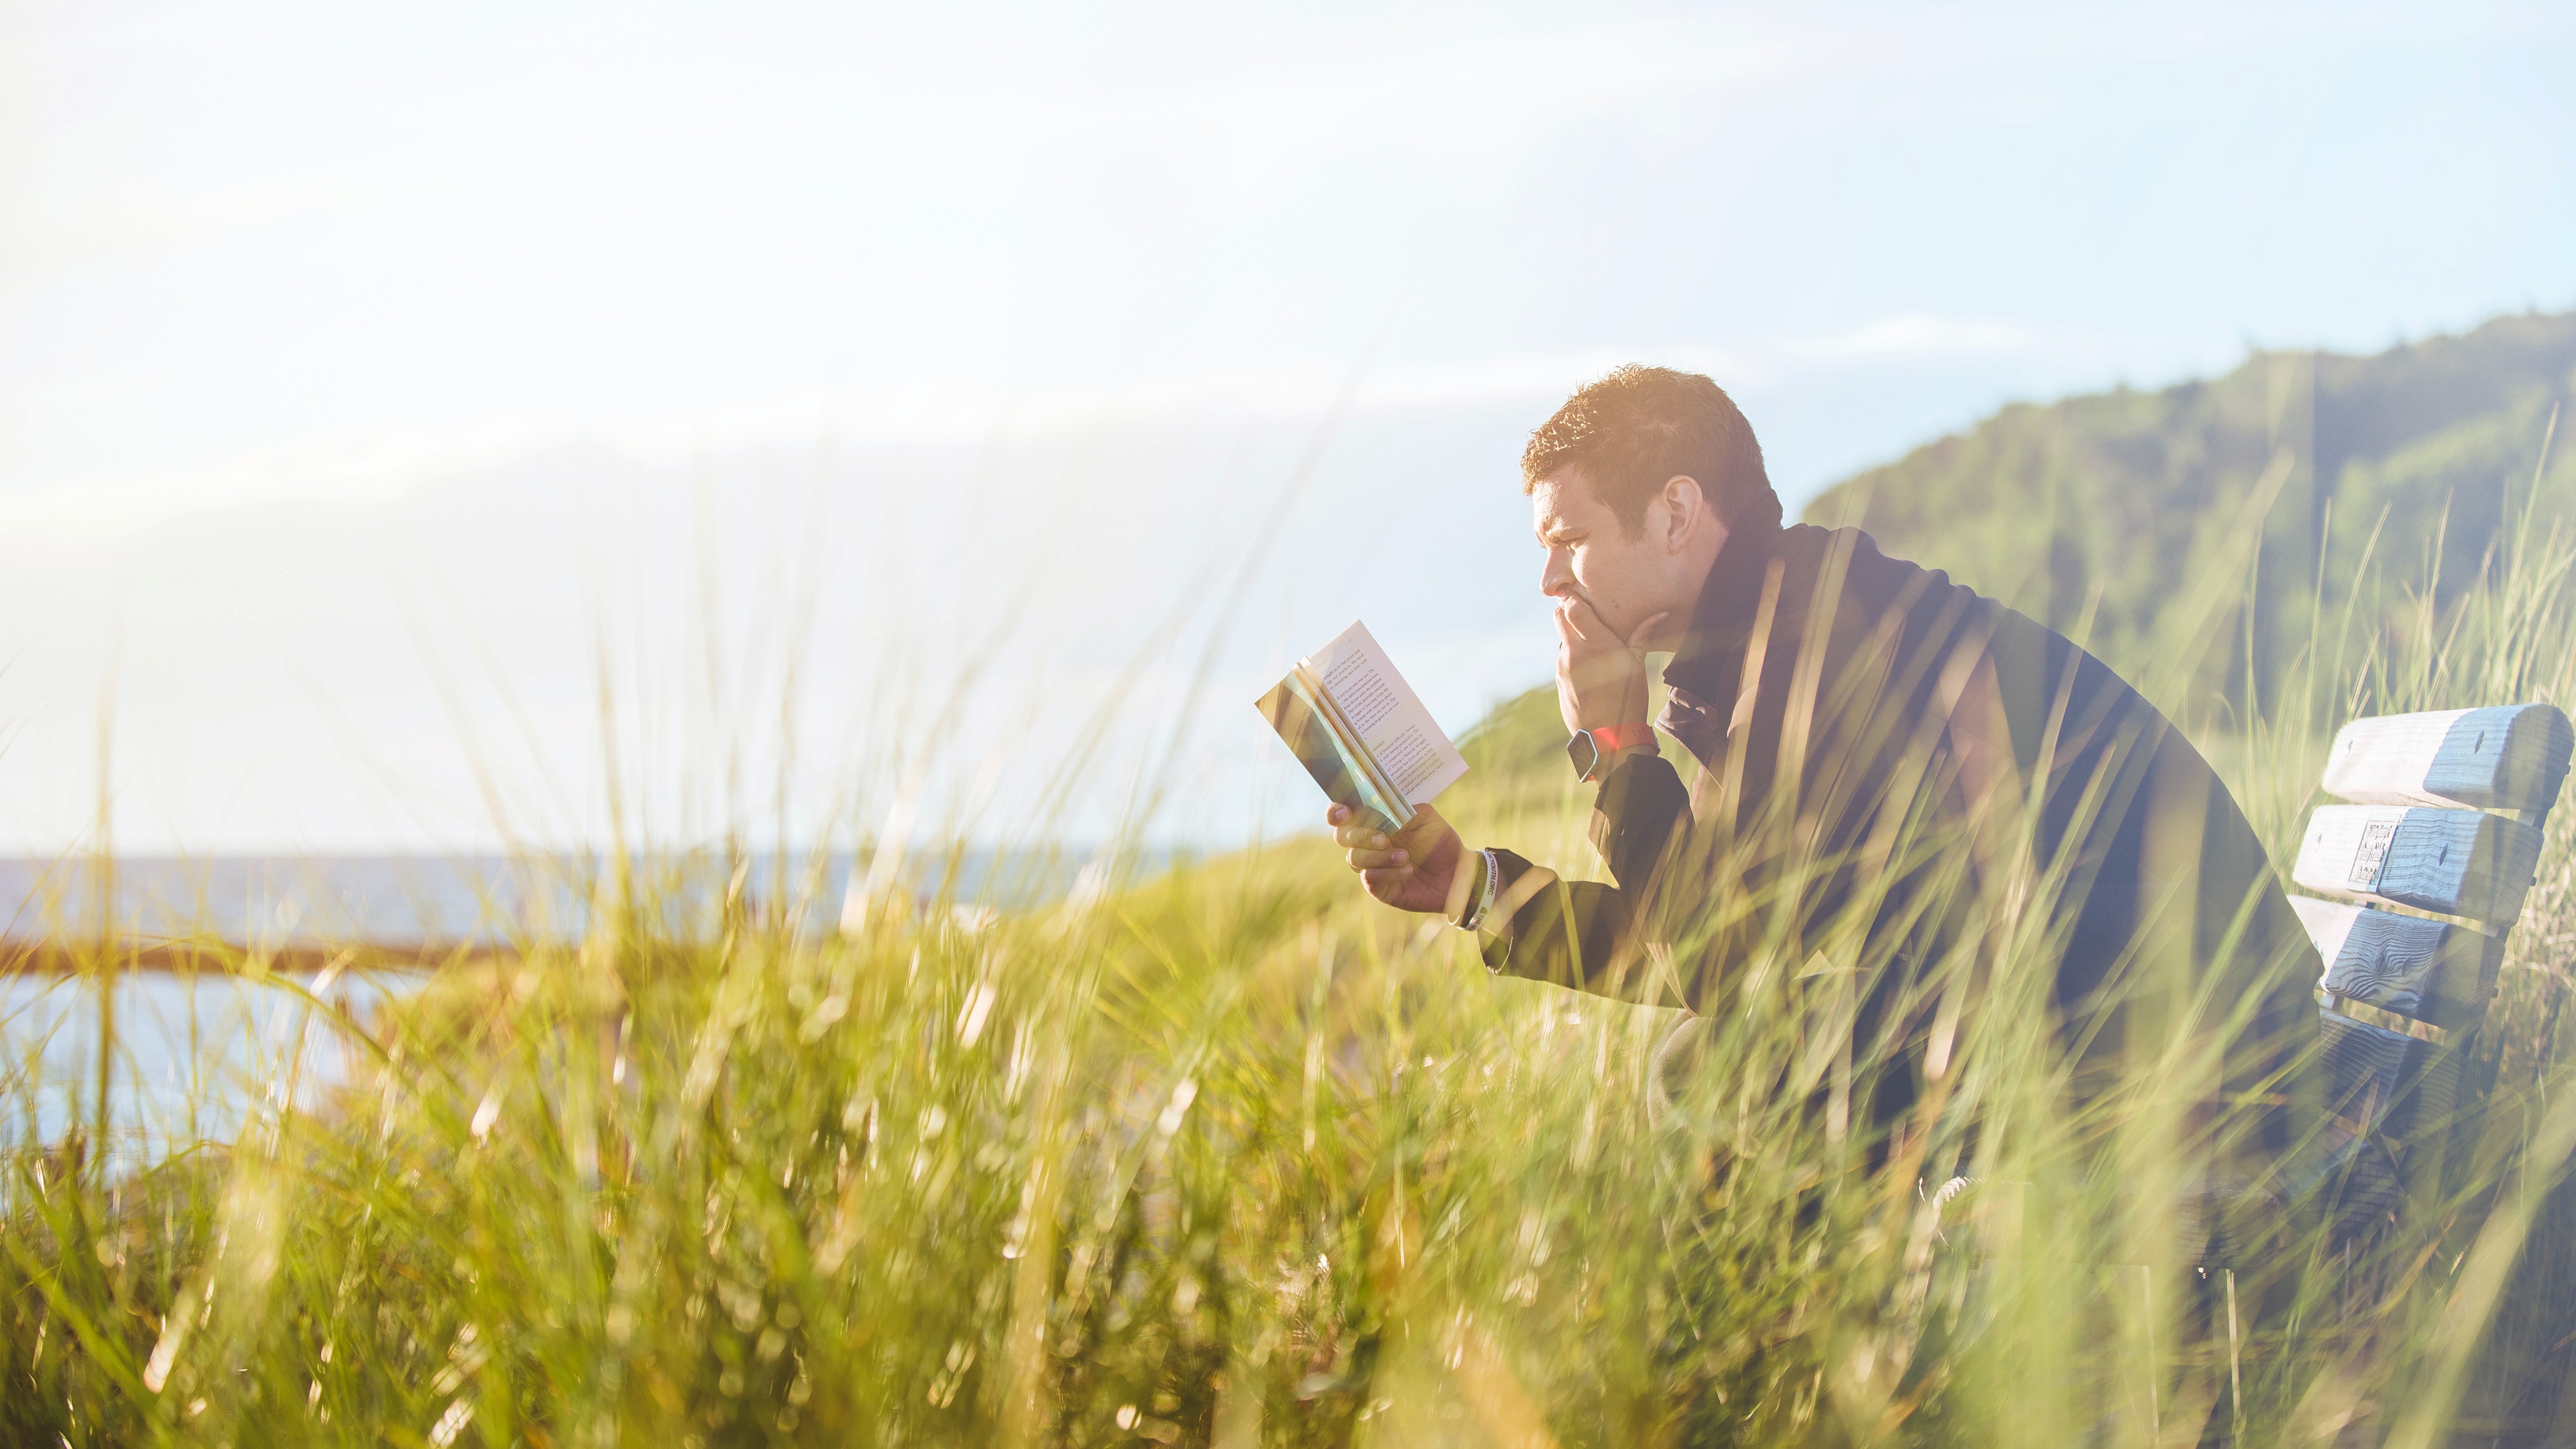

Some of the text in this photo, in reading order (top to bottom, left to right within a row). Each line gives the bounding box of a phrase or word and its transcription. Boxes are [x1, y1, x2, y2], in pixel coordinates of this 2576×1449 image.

[1323, 671, 1334, 680] rought
[1338, 665, 1351, 676] practices.
[1334, 675, 1348, 686] spending,
[1355, 678, 1372, 693] consolidation
[1370, 678, 1382, 689] problem
[1362, 692, 1374, 702] desirable
[1374, 683, 1385, 693] outcome
[1351, 710, 1362, 719] struggle
[1365, 698, 1377, 708] learning
[1356, 714, 1366, 722] honest
[1373, 699, 1385, 710] ourselves
[1364, 722, 1376, 732] learning
[1382, 742, 1394, 753] financial
[1406, 724, 1415, 733] beware
[1388, 750, 1403, 763] compound
[1409, 737, 1418, 746] mistake
[1389, 745, 1399, 754] eternal
[1391, 759, 1402, 768] During
[1403, 747, 1415, 758] financial
[1415, 739, 1426, 748] struggle
[1415, 756, 1424, 764] money
[1404, 778, 1415, 788] worked
[1417, 769, 1426, 778] couple
[1475, 915, 1485, 925] THE
